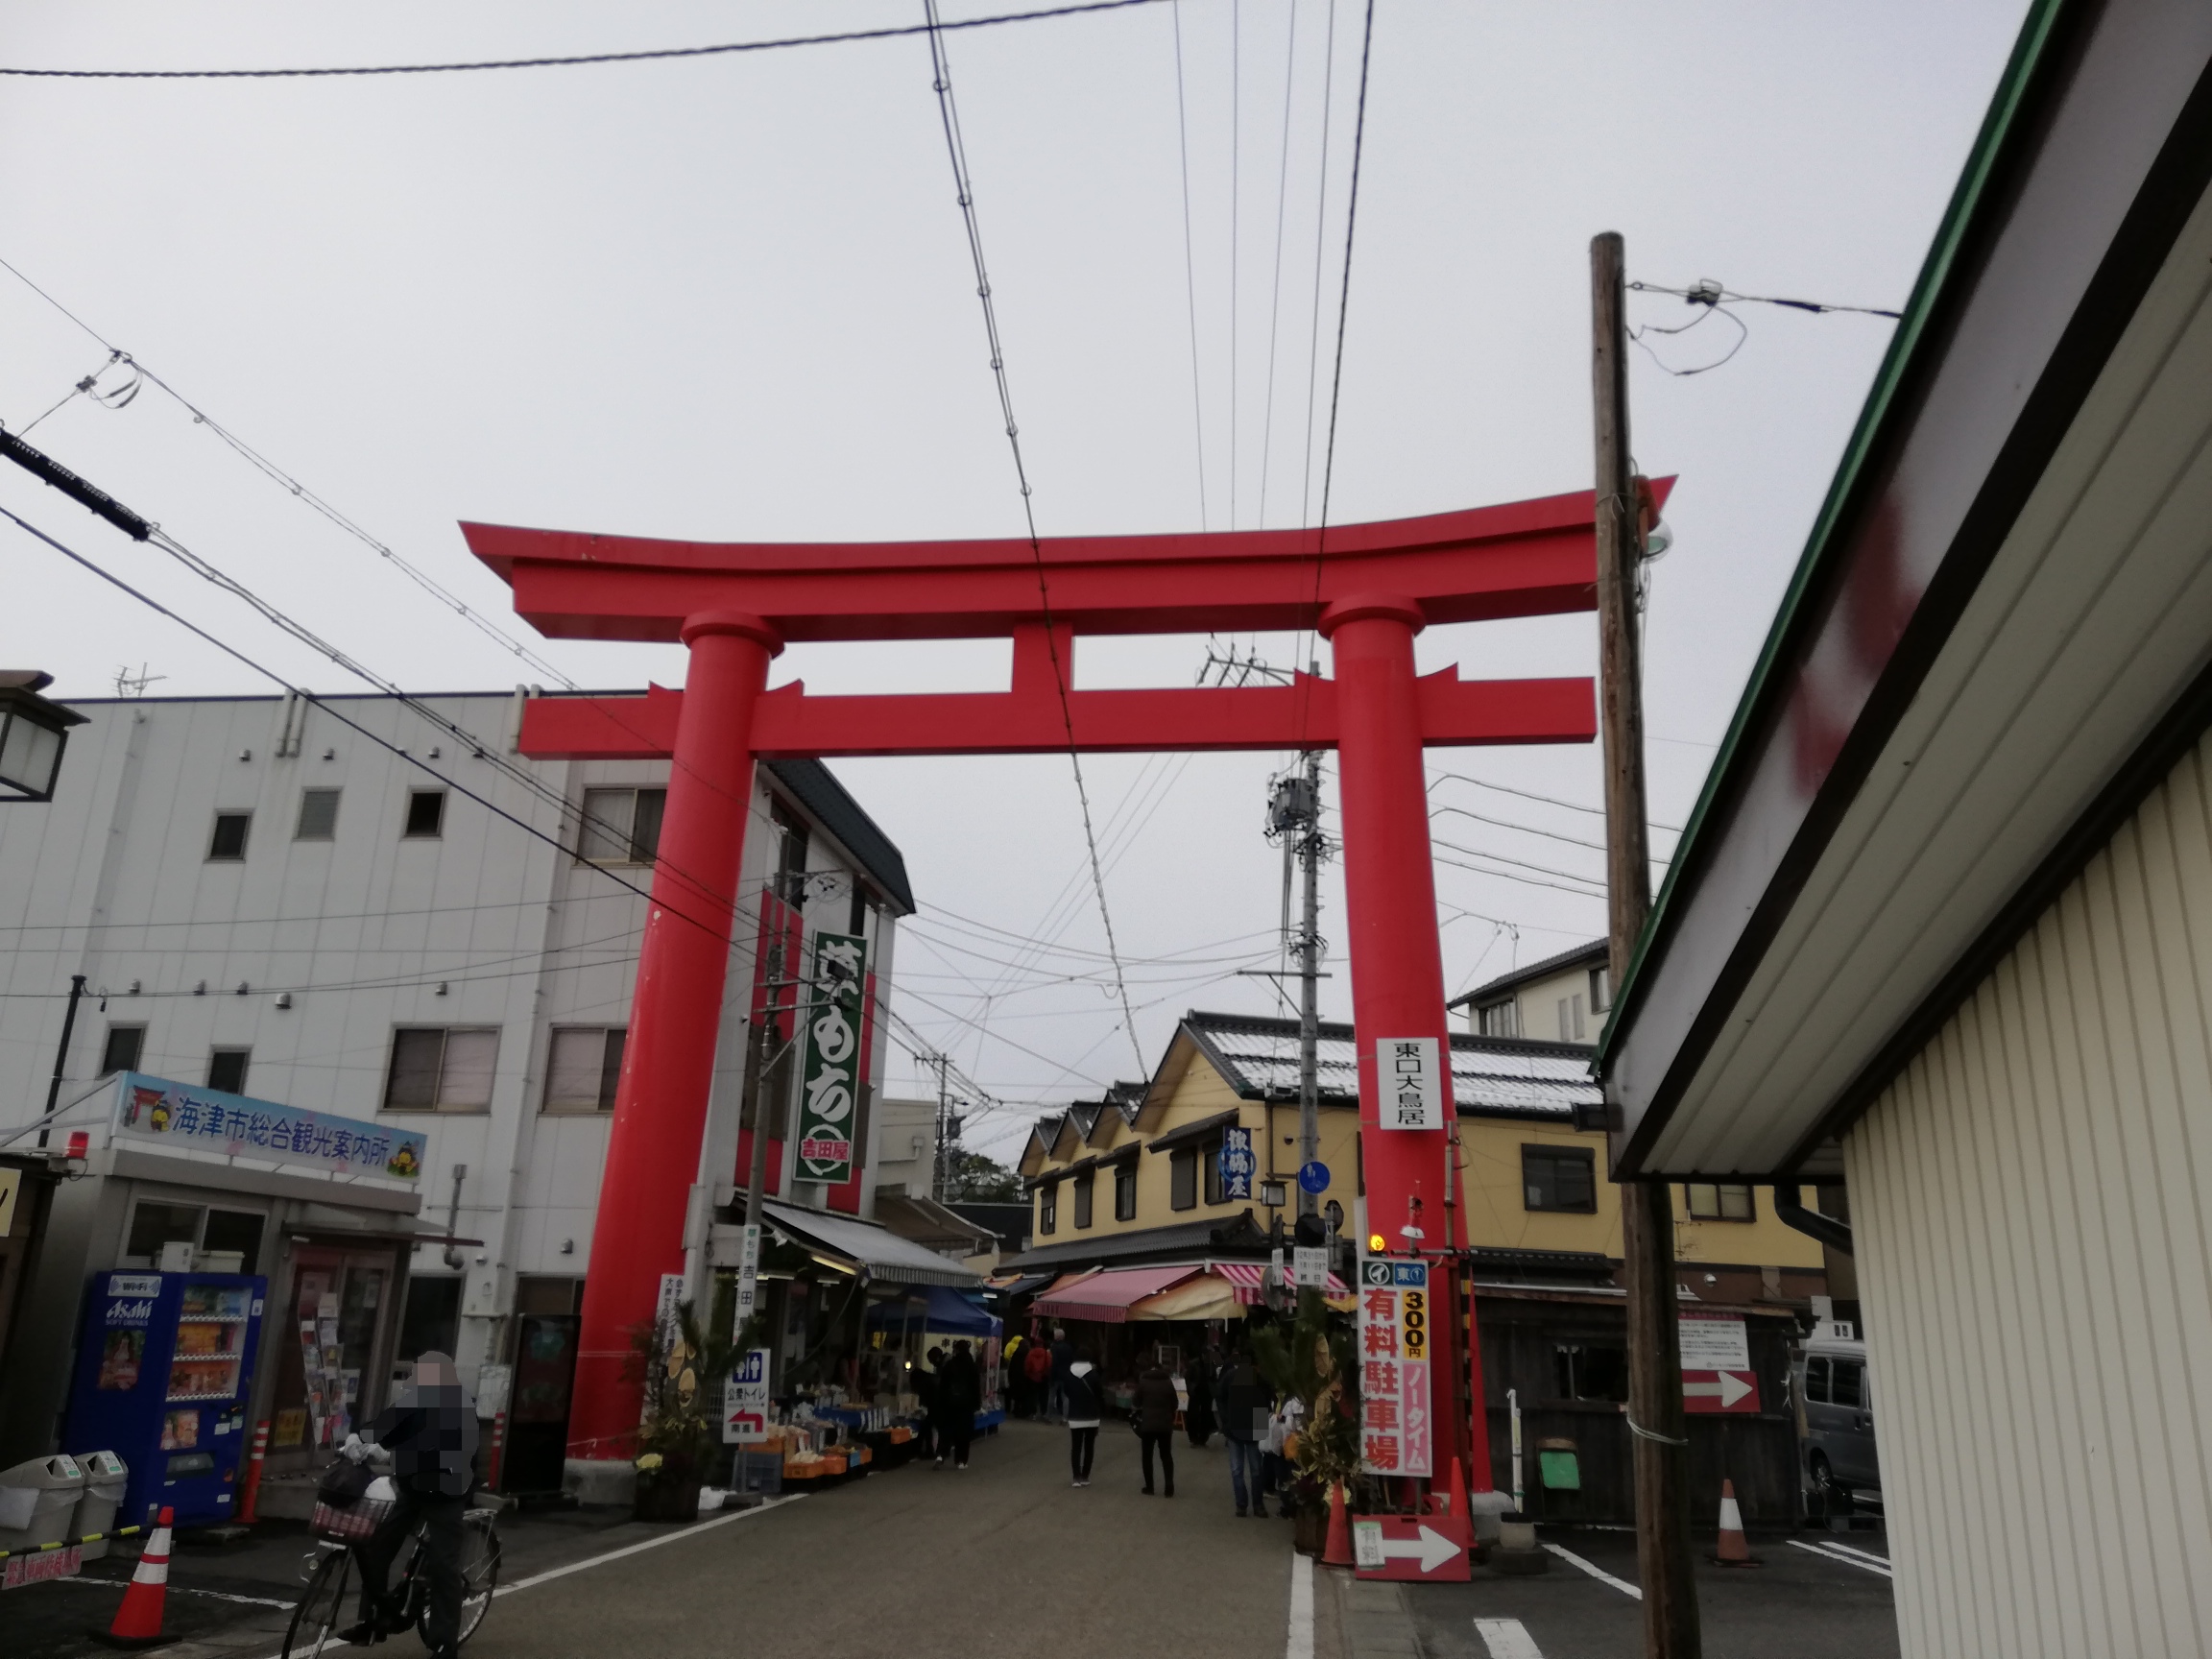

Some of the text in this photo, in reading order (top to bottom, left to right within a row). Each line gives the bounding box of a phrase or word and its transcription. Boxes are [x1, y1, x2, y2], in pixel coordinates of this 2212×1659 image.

[1394, 1043, 1426, 1125] 東口大鳥居
[172, 1096, 391, 1166] 海津市総合観光案内所
[801, 1138, 851, 1163] 吉田屋
[106, 1299, 154, 1319] Asahi
[1405, 1291, 1425, 1358] 300円
[728, 1387, 766, 1402] 公衆トイレ
[1363, 1287, 1400, 1472] 有料駐車場
[1407, 1367, 1427, 1472] ノータイム
